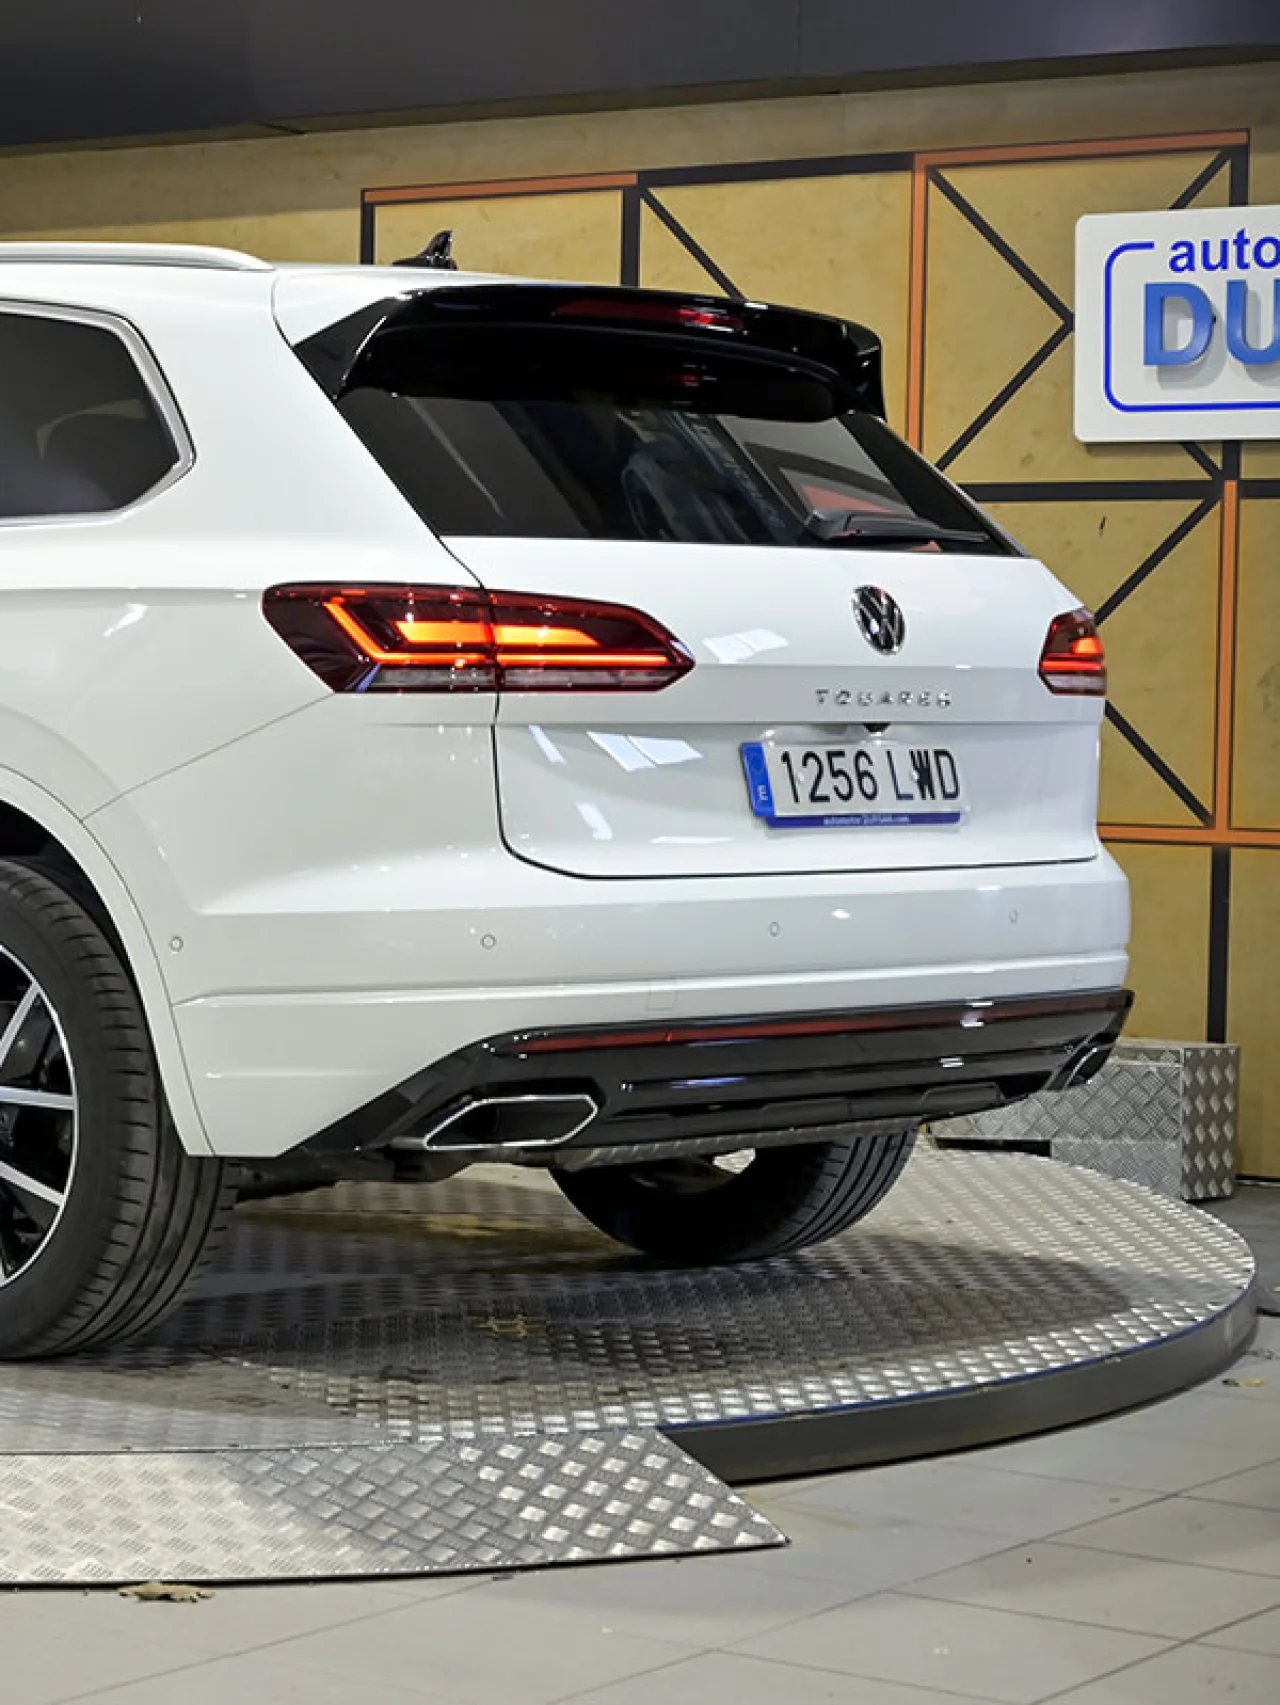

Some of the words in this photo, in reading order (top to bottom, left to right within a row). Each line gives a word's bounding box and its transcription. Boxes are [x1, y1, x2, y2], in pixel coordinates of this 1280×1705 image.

[1169, 228, 1280, 274] auto
[1143, 279, 1280, 367] DU
[780, 750, 878, 803] 1256
[886, 748, 960, 800] LWD
